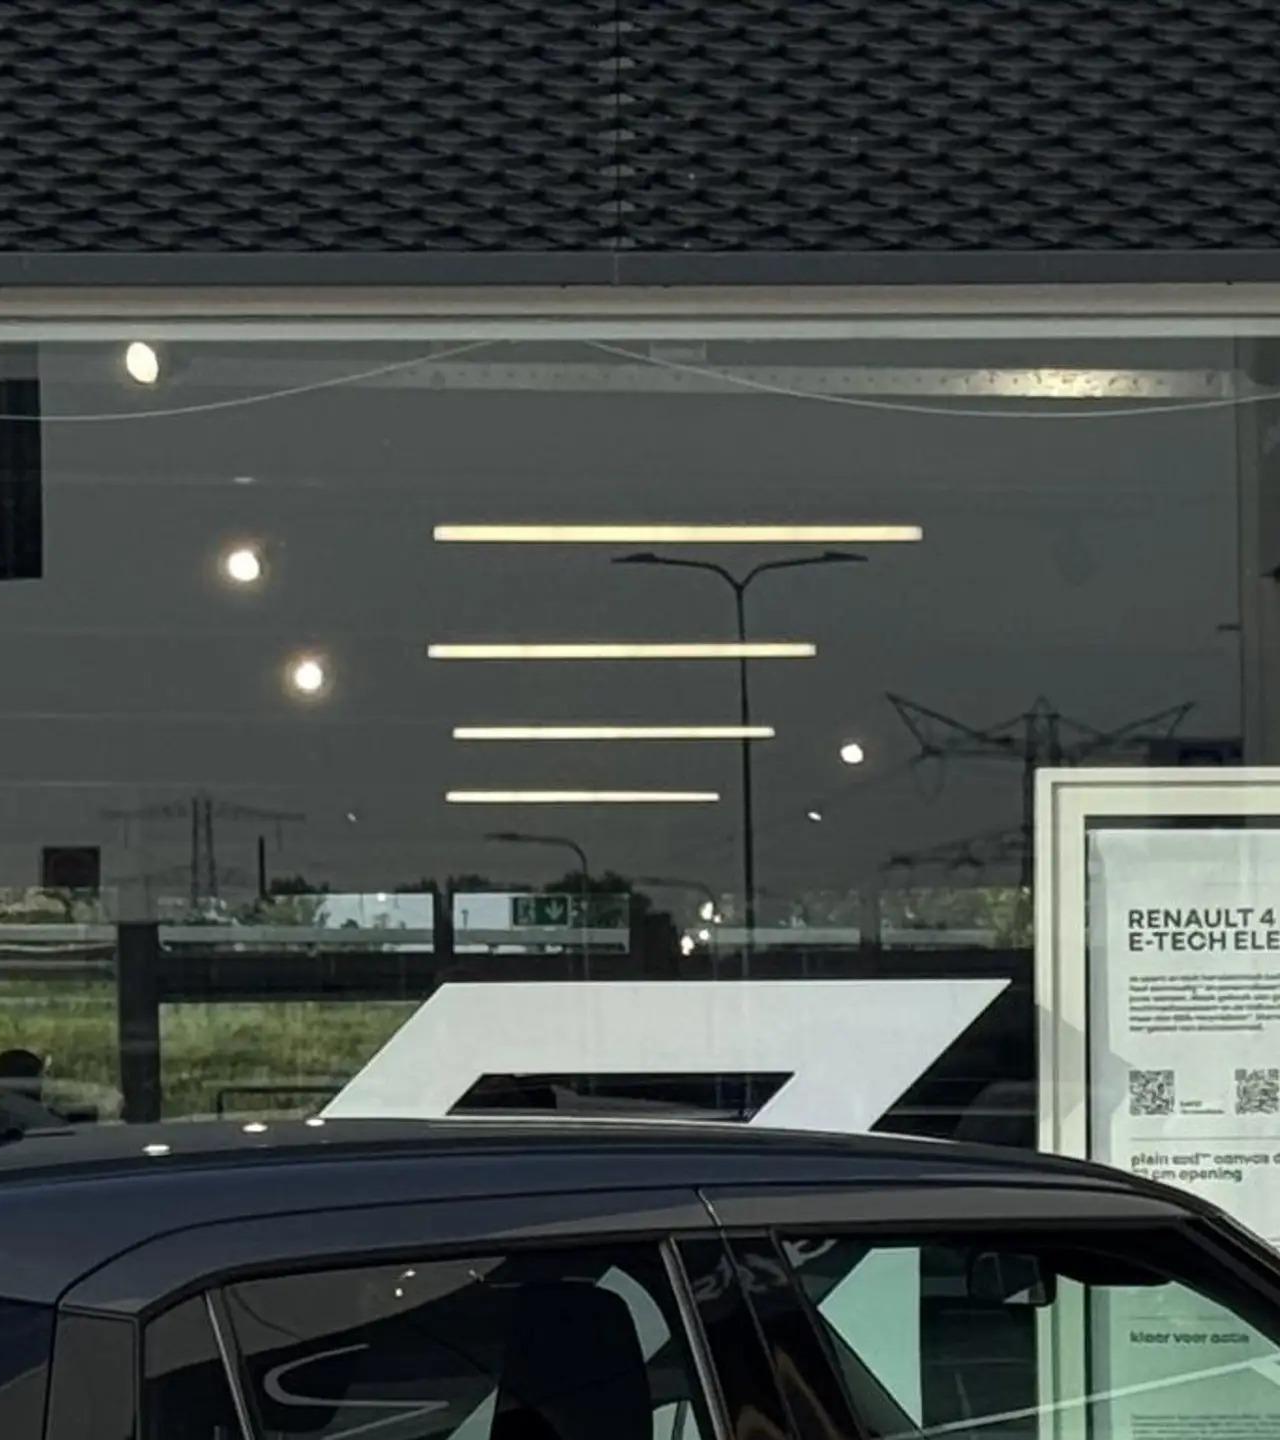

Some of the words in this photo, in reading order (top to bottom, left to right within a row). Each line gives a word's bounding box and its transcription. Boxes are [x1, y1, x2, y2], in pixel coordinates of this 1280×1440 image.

[1128, 908, 1254, 929] RENAULT
[1258, 908, 1276, 928] 4
[1129, 931, 1226, 951] E-TECH
[1178, 1167, 1243, 1183] opening
